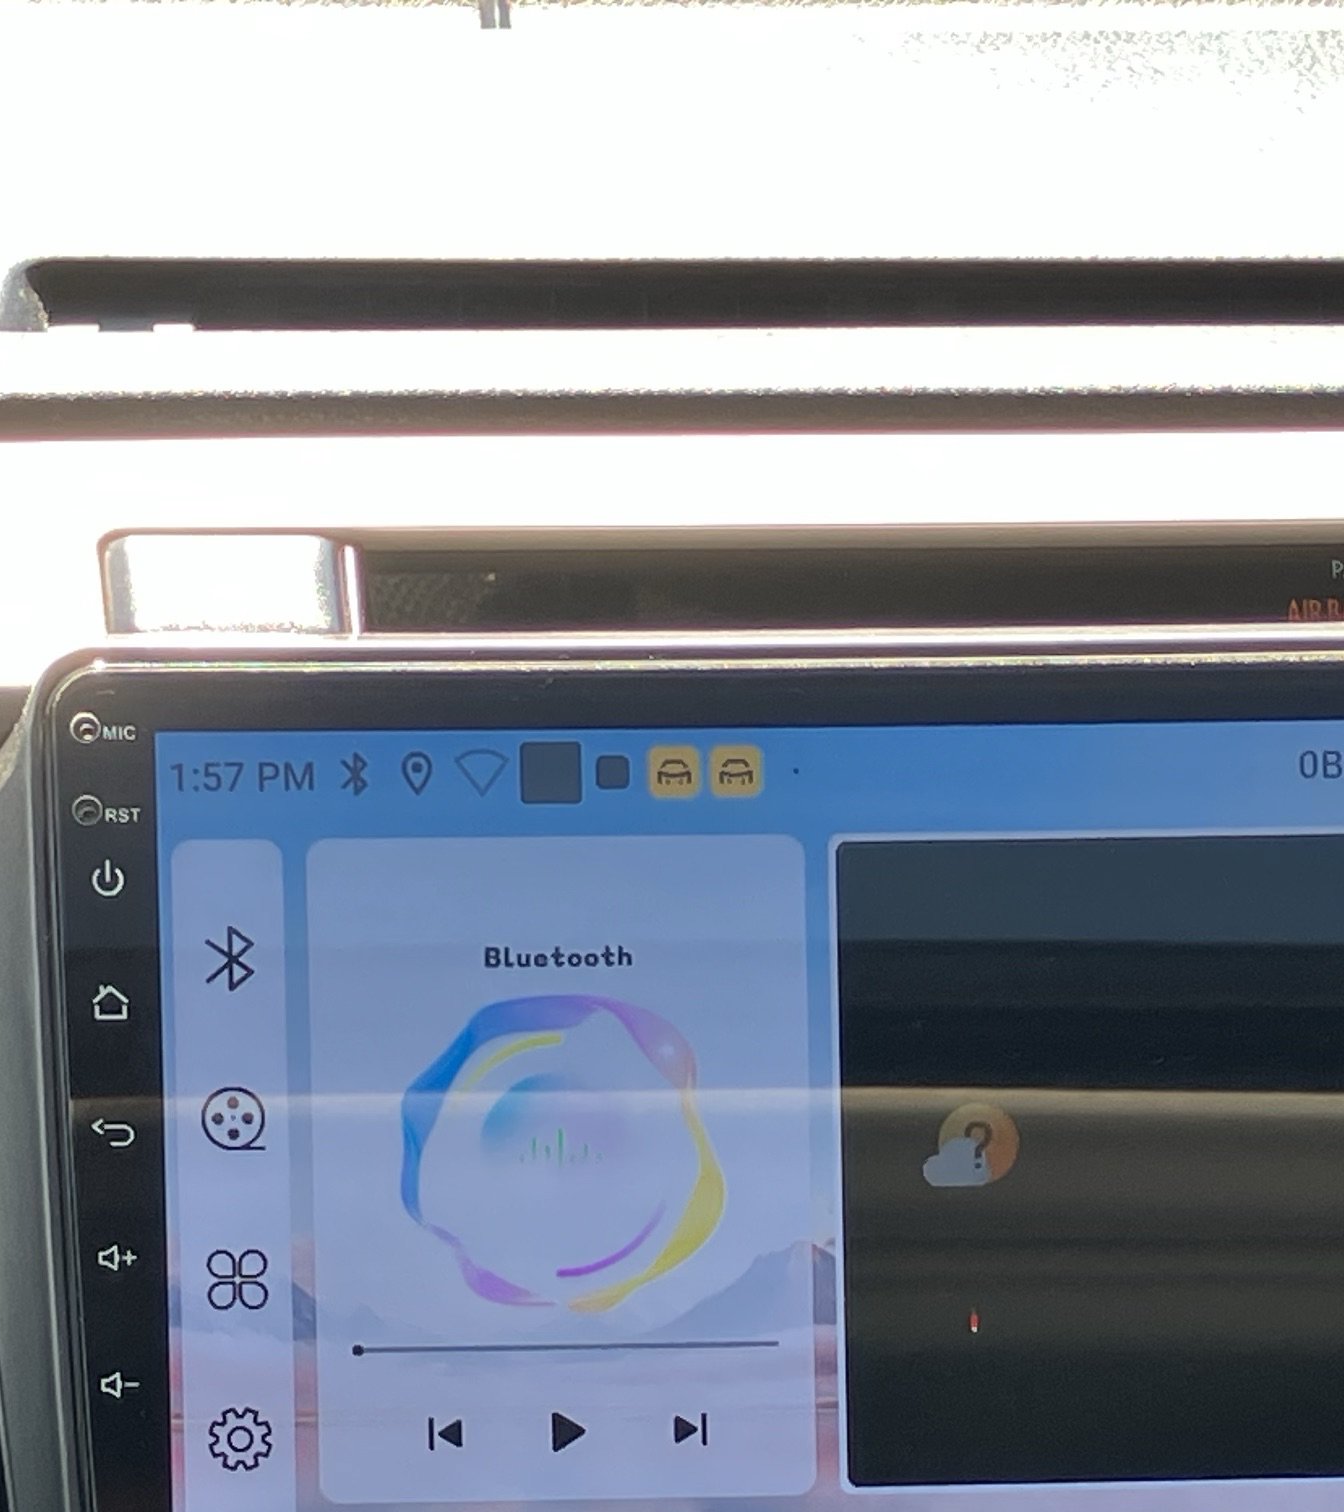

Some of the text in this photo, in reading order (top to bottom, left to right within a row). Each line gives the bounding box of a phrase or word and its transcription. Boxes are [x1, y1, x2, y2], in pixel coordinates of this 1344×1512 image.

[102, 724, 136, 741] MIC
[169, 761, 316, 793] 1:57 PM
[104, 806, 142, 824] RST
[483, 945, 634, 970] Bluetooth
